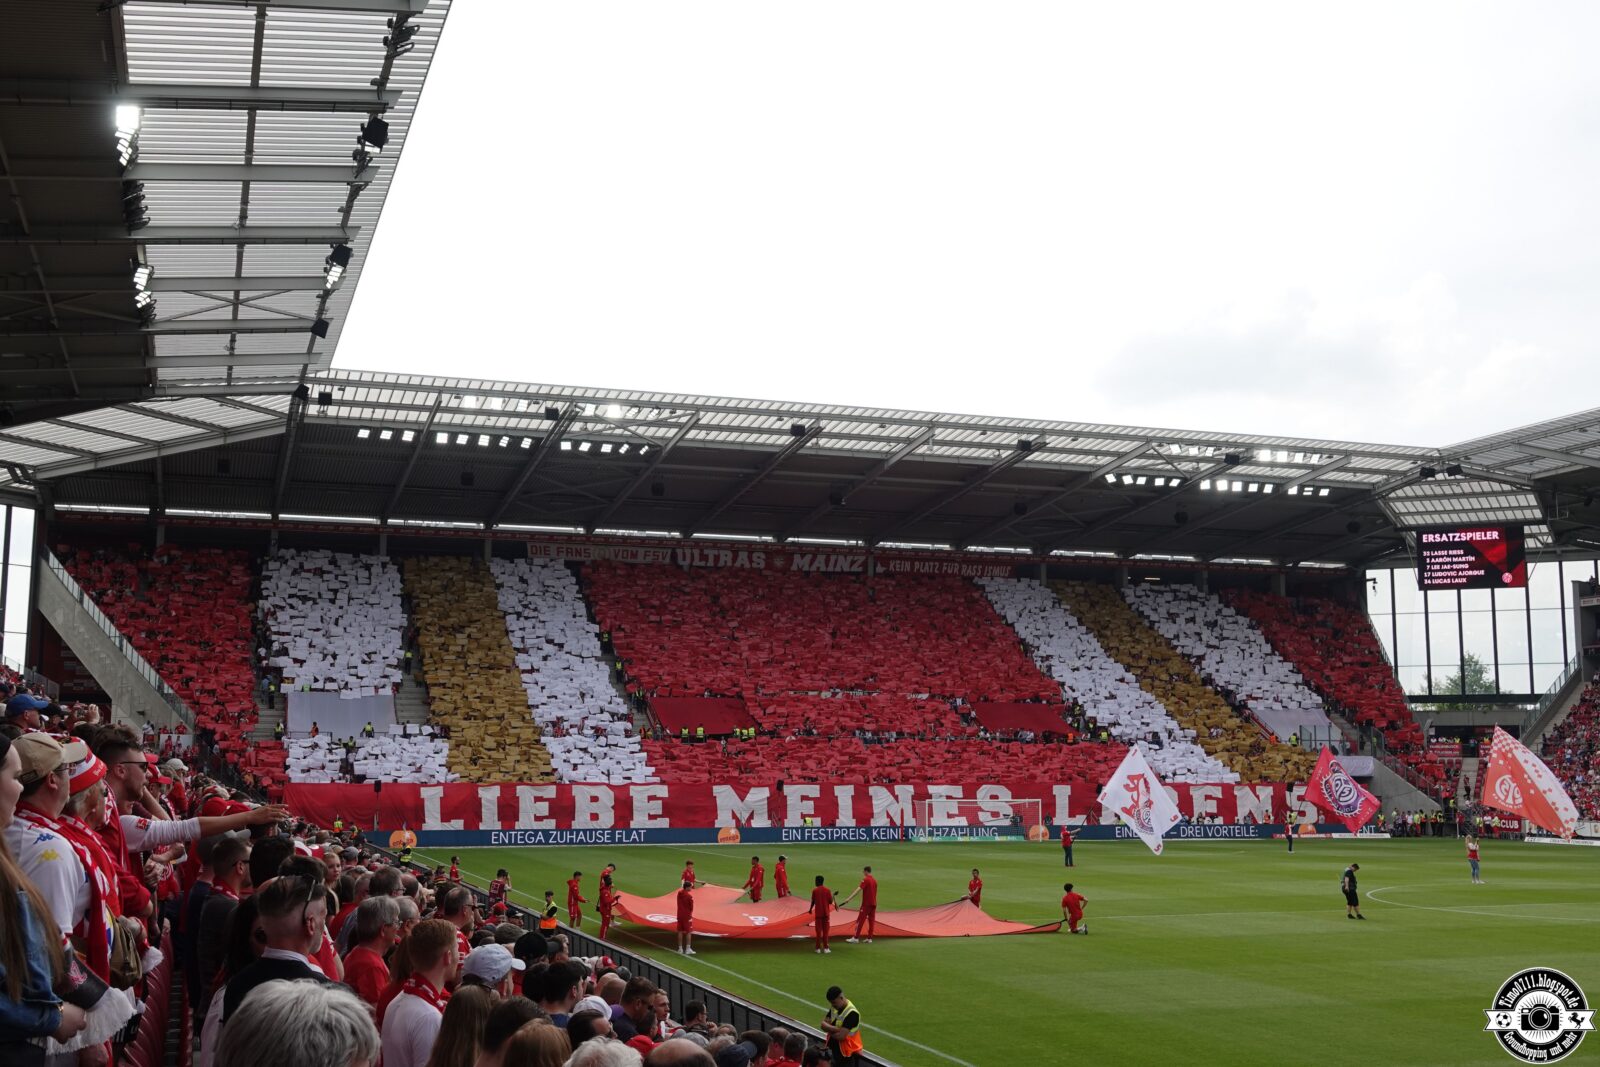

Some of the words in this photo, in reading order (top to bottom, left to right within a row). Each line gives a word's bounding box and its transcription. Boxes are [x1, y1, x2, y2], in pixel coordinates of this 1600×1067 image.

[1422, 531, 1500, 542] ERSATZSPIELER
[530, 544, 551, 556] DIE
[556, 546, 592, 558] FANS
[644, 550, 669, 562] FSV
[675, 548, 766, 568] ULTRAS
[790, 554, 865, 572] MAINZ
[889, 561, 911, 572] KEIN
[914, 561, 940, 574] PLATZ
[420, 785, 670, 830] LIEBE
[712, 784, 1014, 828] MEINES
[1500, 820, 1519, 828] CLUB
[491, 831, 544, 844] ENTEGA
[549, 830, 612, 844] ZUHAUSE
[616, 829, 646, 842] FLAT
[782, 828, 801, 840] EIN
[804, 828, 870, 842] FESTPREIS,
[1181, 826, 1203, 838] DREI
[1206, 826, 1258, 838] VORTEILE:
